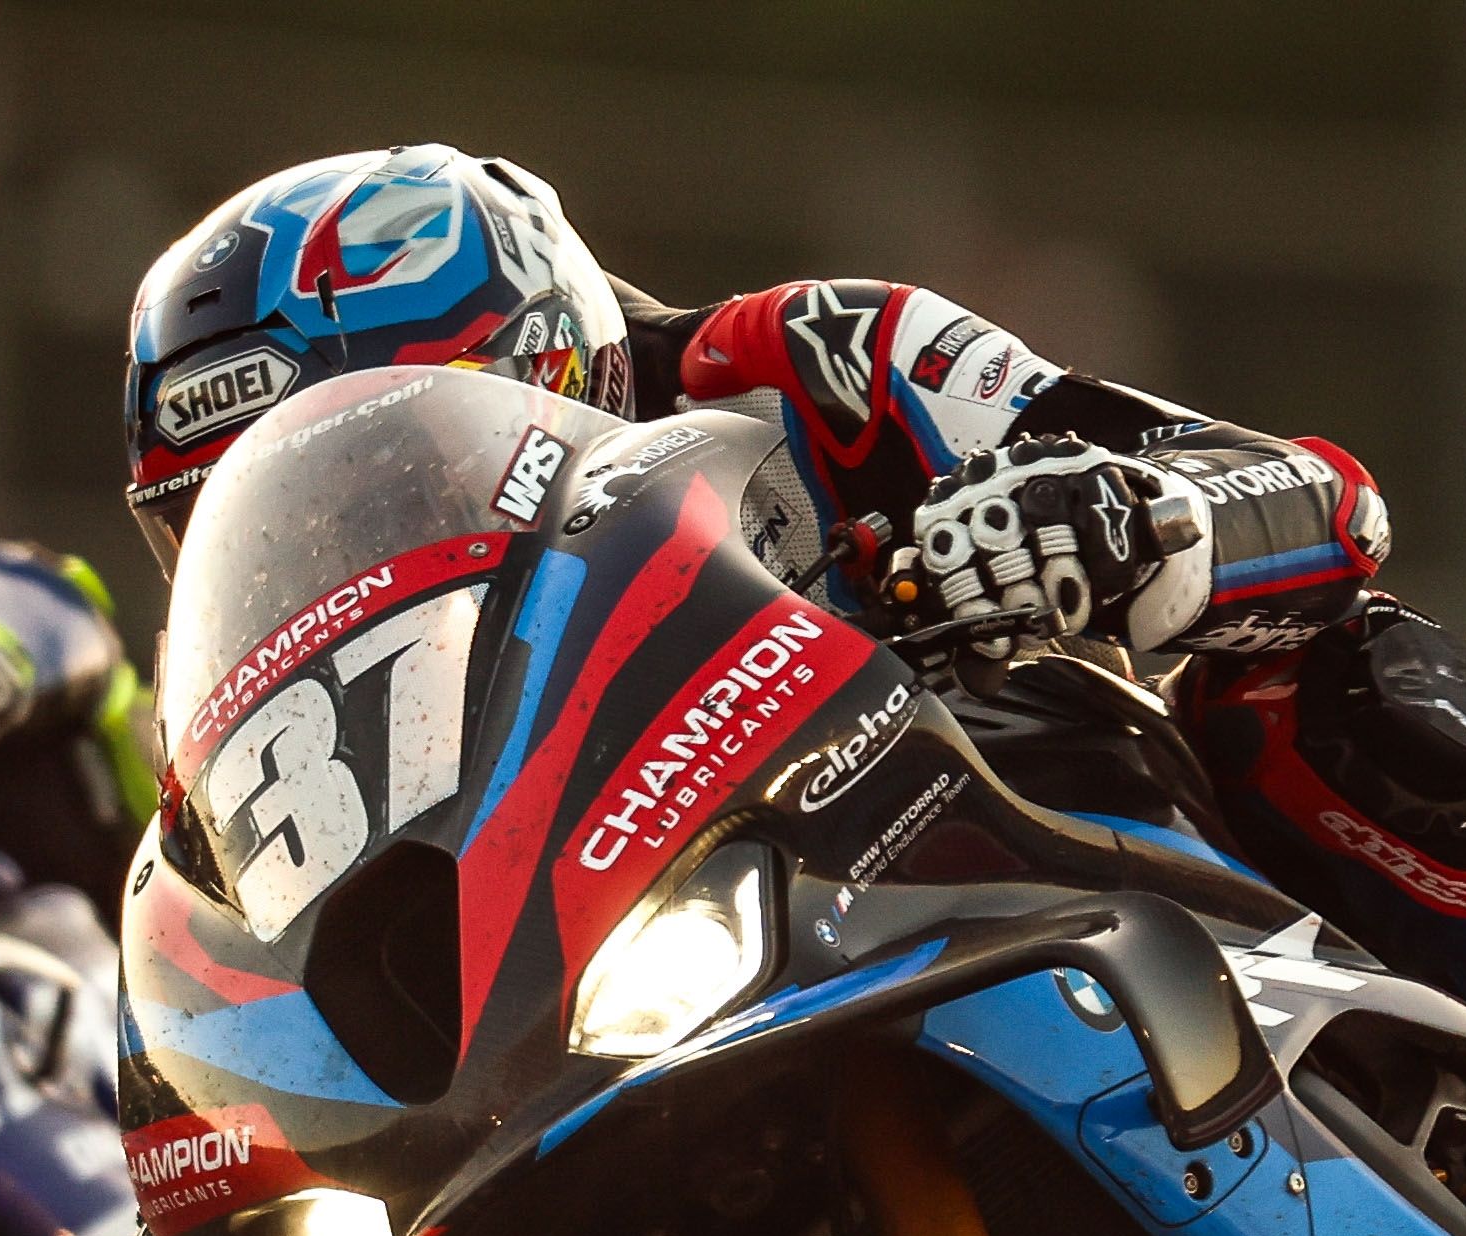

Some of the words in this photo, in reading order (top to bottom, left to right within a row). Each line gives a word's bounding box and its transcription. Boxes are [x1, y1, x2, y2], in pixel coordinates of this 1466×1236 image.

[168, 359, 277, 431] SHOEI
[635, 426, 708, 463] HORECA
[495, 428, 565, 522] WRS
[1195, 454, 1334, 505] OTORRAD
[190, 564, 397, 745] CHAMPION
[215, 606, 365, 736] LUBRICANTS
[207, 580, 488, 945] 37
[579, 610, 824, 873] CHAMPION
[643, 664, 816, 850] LUBRICANTS
[810, 682, 911, 796] alpha
[849, 840, 881, 880] BMW
[882, 773, 950, 847] MOTORRAD
[887, 802, 942, 860] Endurance
[944, 772, 972, 803] Team
[128, 1125, 252, 1188] HAMPION
